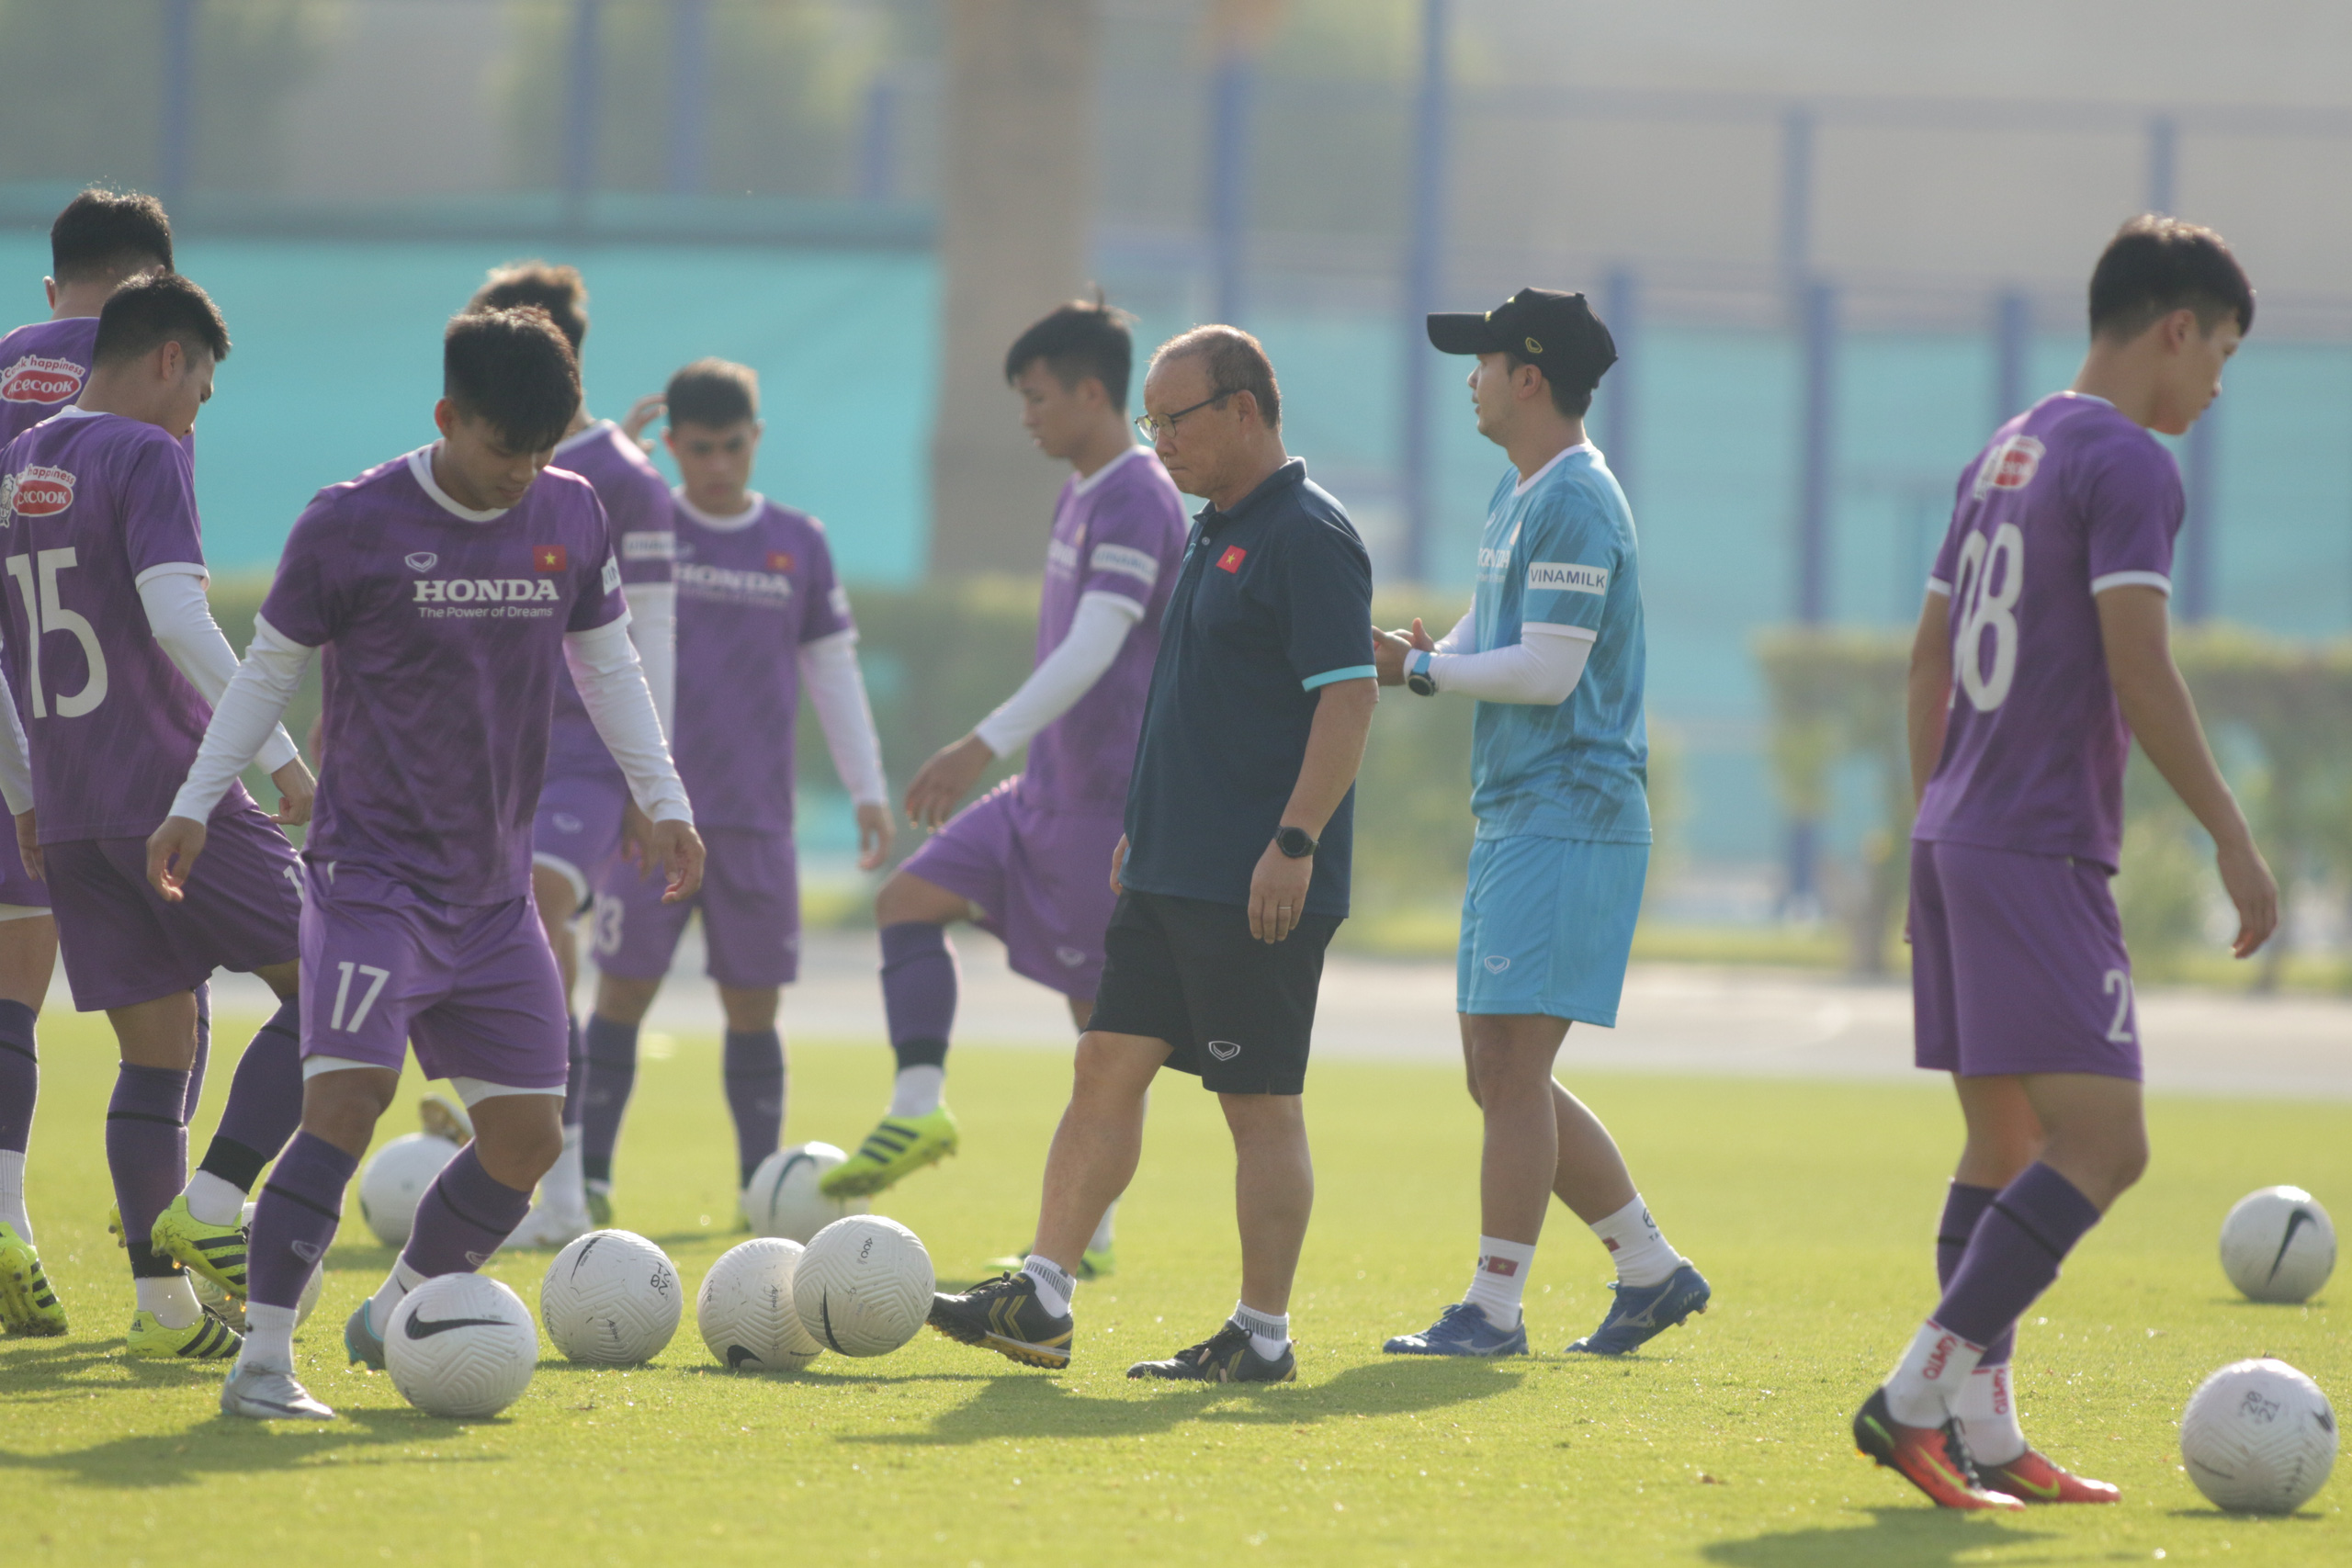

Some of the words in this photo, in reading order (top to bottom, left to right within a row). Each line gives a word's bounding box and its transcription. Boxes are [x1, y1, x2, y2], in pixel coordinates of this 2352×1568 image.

[30, 356, 85, 376] happiness
[1530, 568, 1606, 589] VINAMILK
[413, 579, 560, 603] HONDA
[418, 606, 444, 618] The
[447, 606, 488, 618] Power
[491, 605, 505, 617] of
[508, 606, 553, 617] Dreams
[6, 547, 108, 718] 15
[331, 961, 390, 1033] 17
[2104, 969, 2133, 1043] 2
